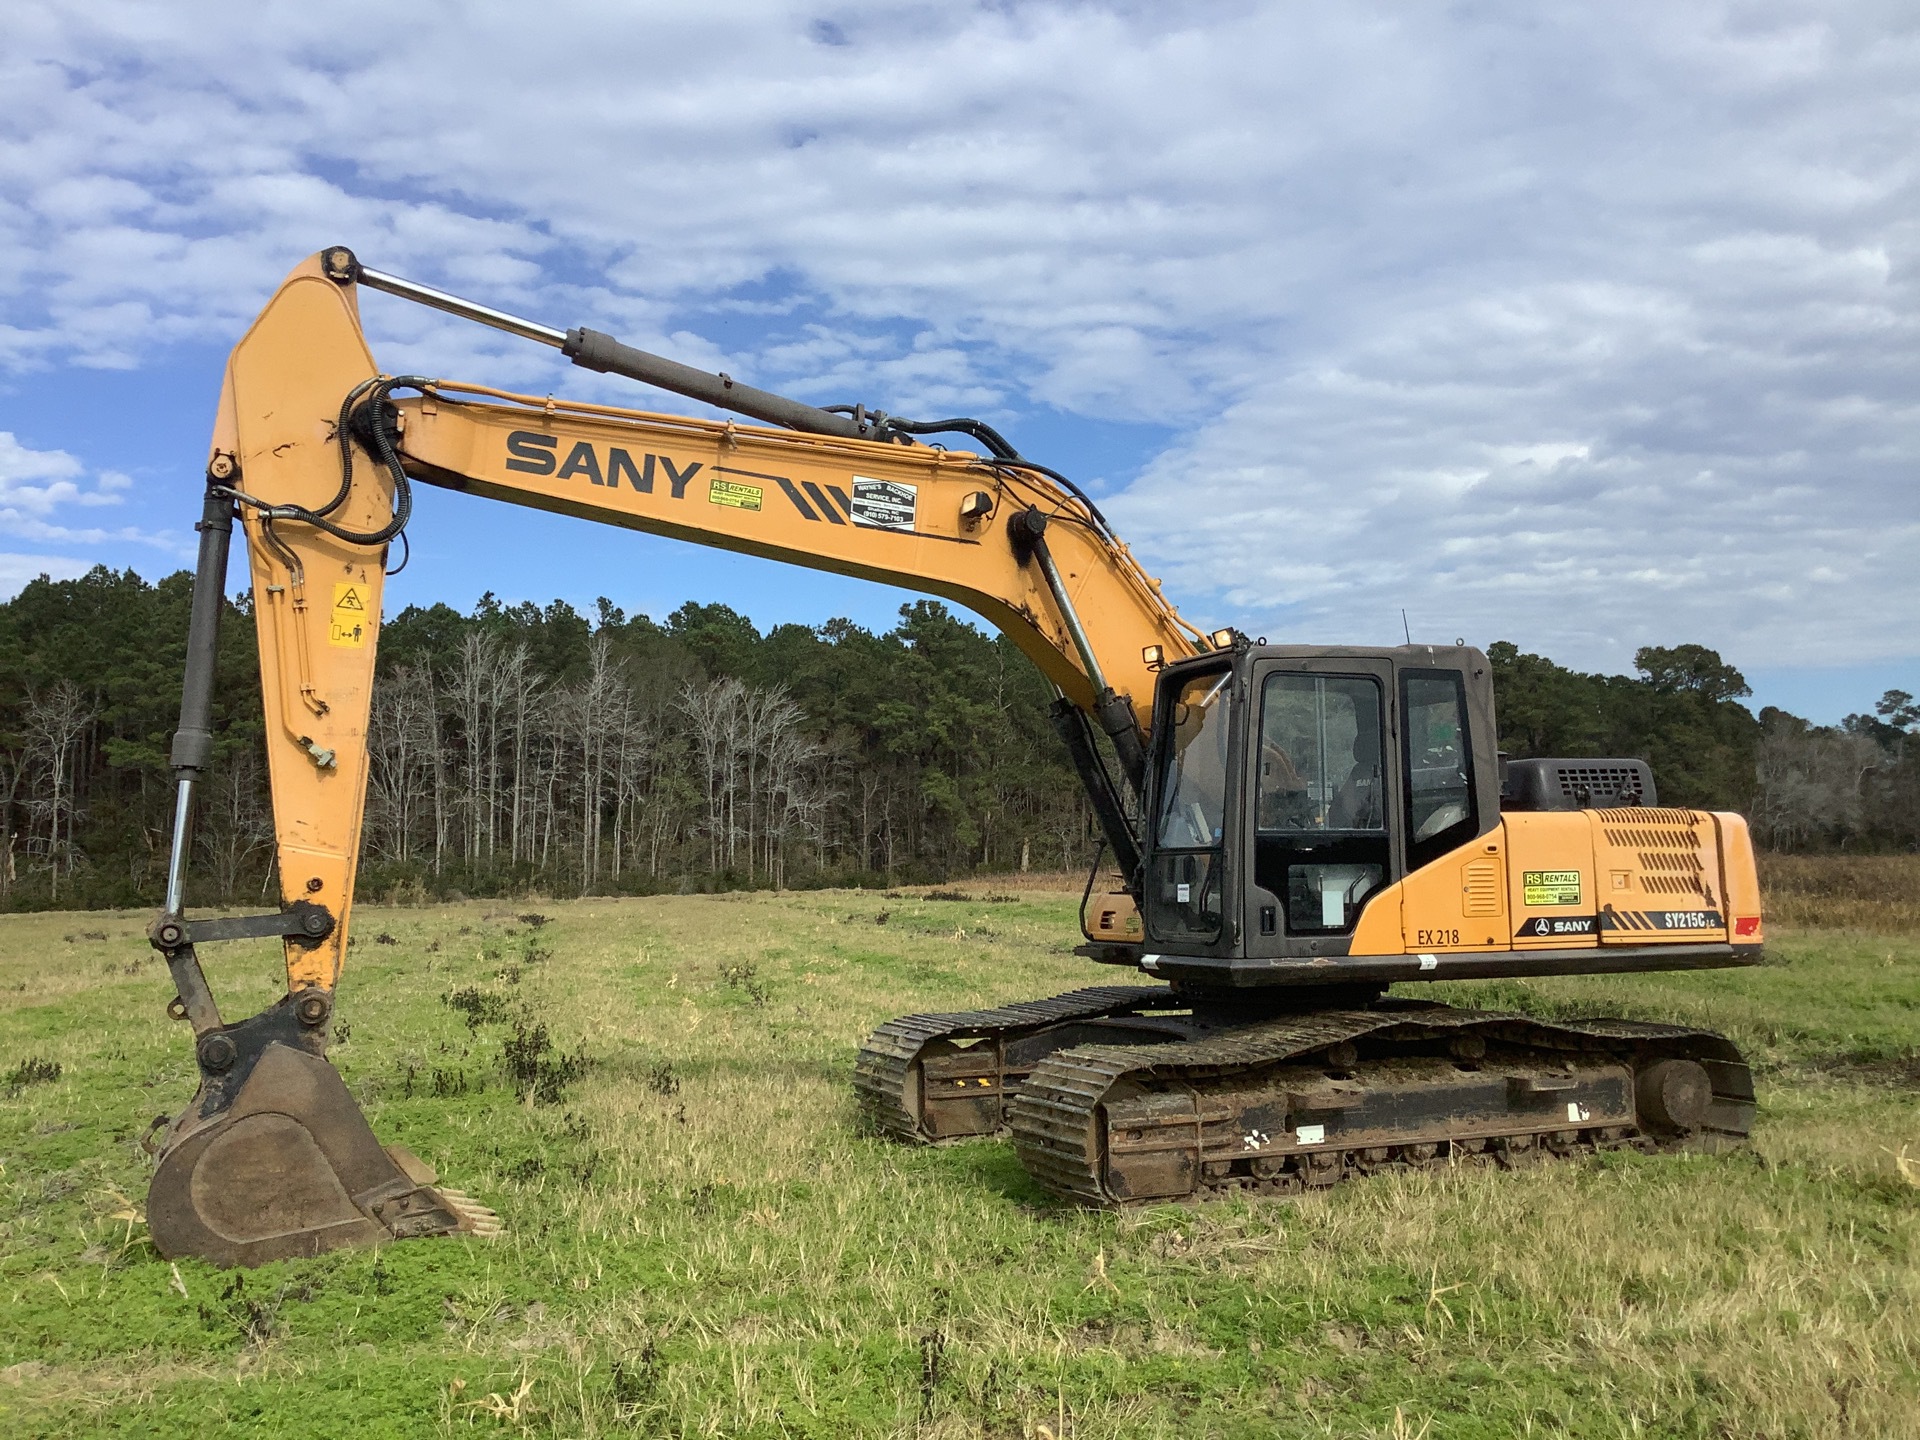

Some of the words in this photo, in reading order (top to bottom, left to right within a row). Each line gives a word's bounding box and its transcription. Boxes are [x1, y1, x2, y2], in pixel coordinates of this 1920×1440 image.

[506, 430, 704, 499] SANY
[713, 481, 727, 490] RS
[730, 484, 760, 495] RENTALS
[886, 485, 913, 501] BACKHOE
[863, 510, 877, 518] (910)
[1526, 874, 1541, 884] RS
[1544, 874, 1577, 883] RENTALS
[1554, 920, 1591, 932] SANY
[1665, 912, 1706, 928] SY215C
[1418, 930, 1433, 945] EX
[1437, 929, 1459, 944] 218
